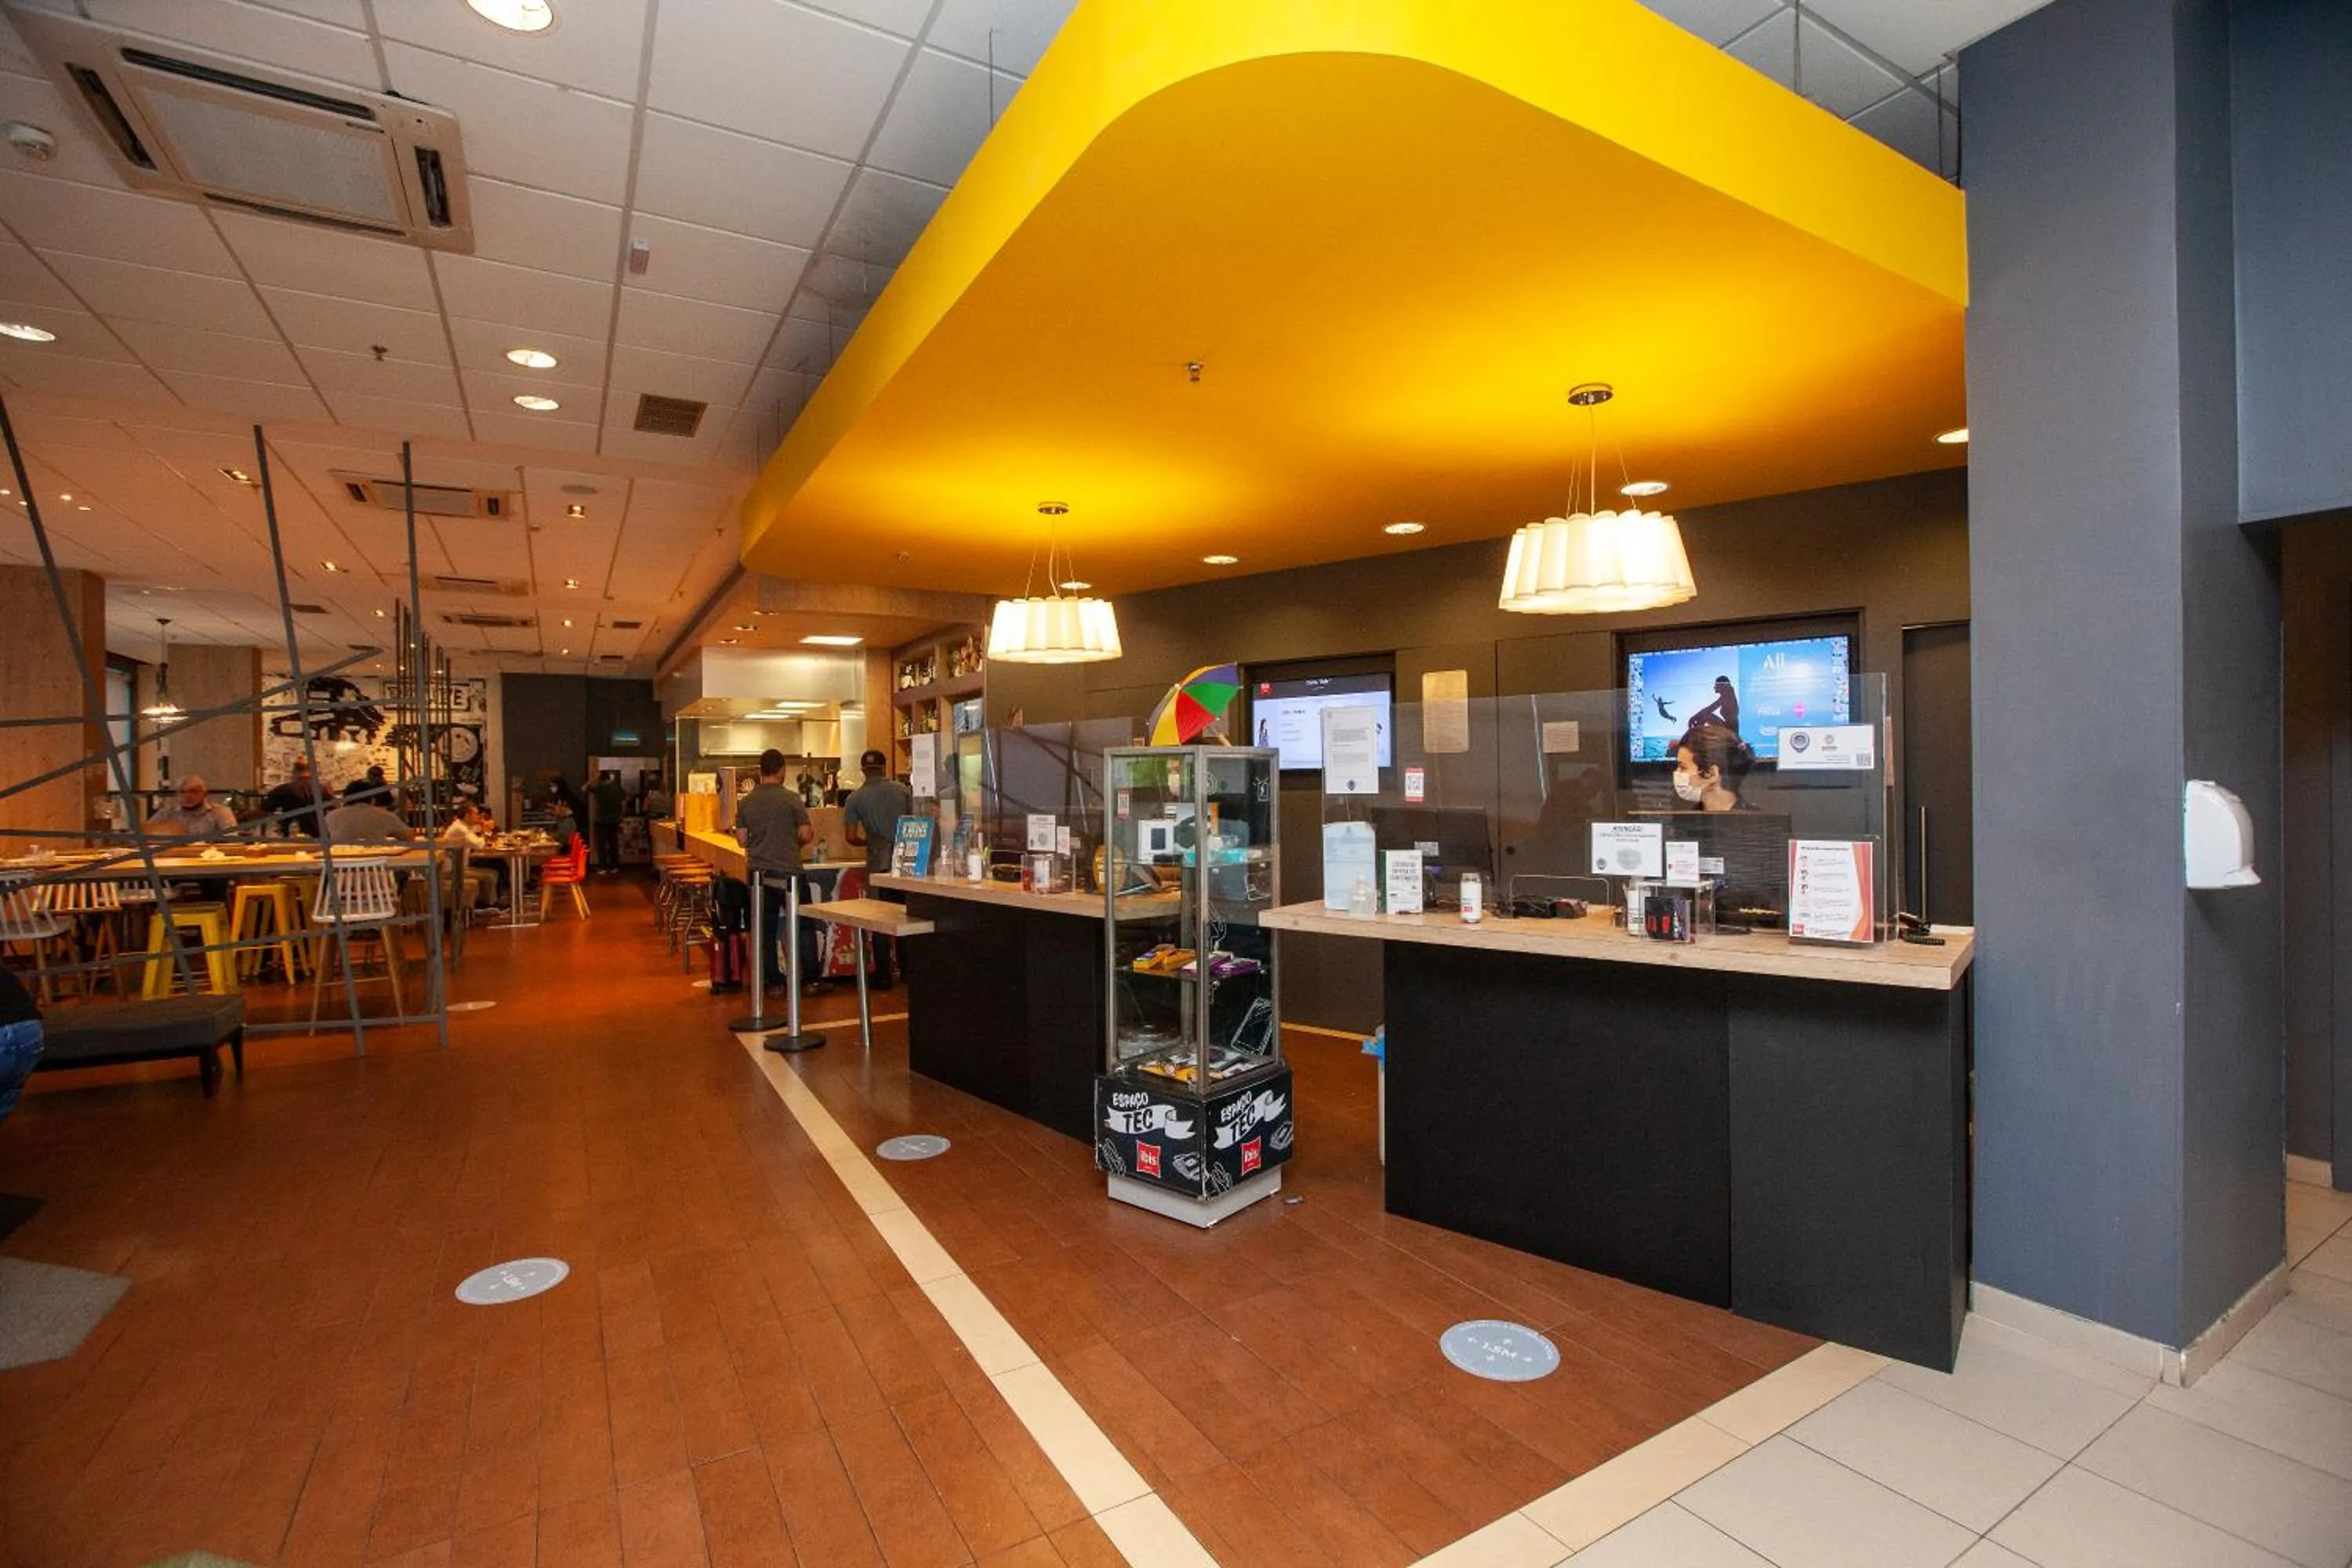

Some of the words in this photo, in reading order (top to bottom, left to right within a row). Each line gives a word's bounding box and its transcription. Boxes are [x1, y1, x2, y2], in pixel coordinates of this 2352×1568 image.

[1112, 1092, 1149, 1110] ESPAÇO
[1123, 1109, 1153, 1134] TEC
[1231, 1105, 1255, 1142] TEC
[1141, 1151, 1158, 1166] ibis
